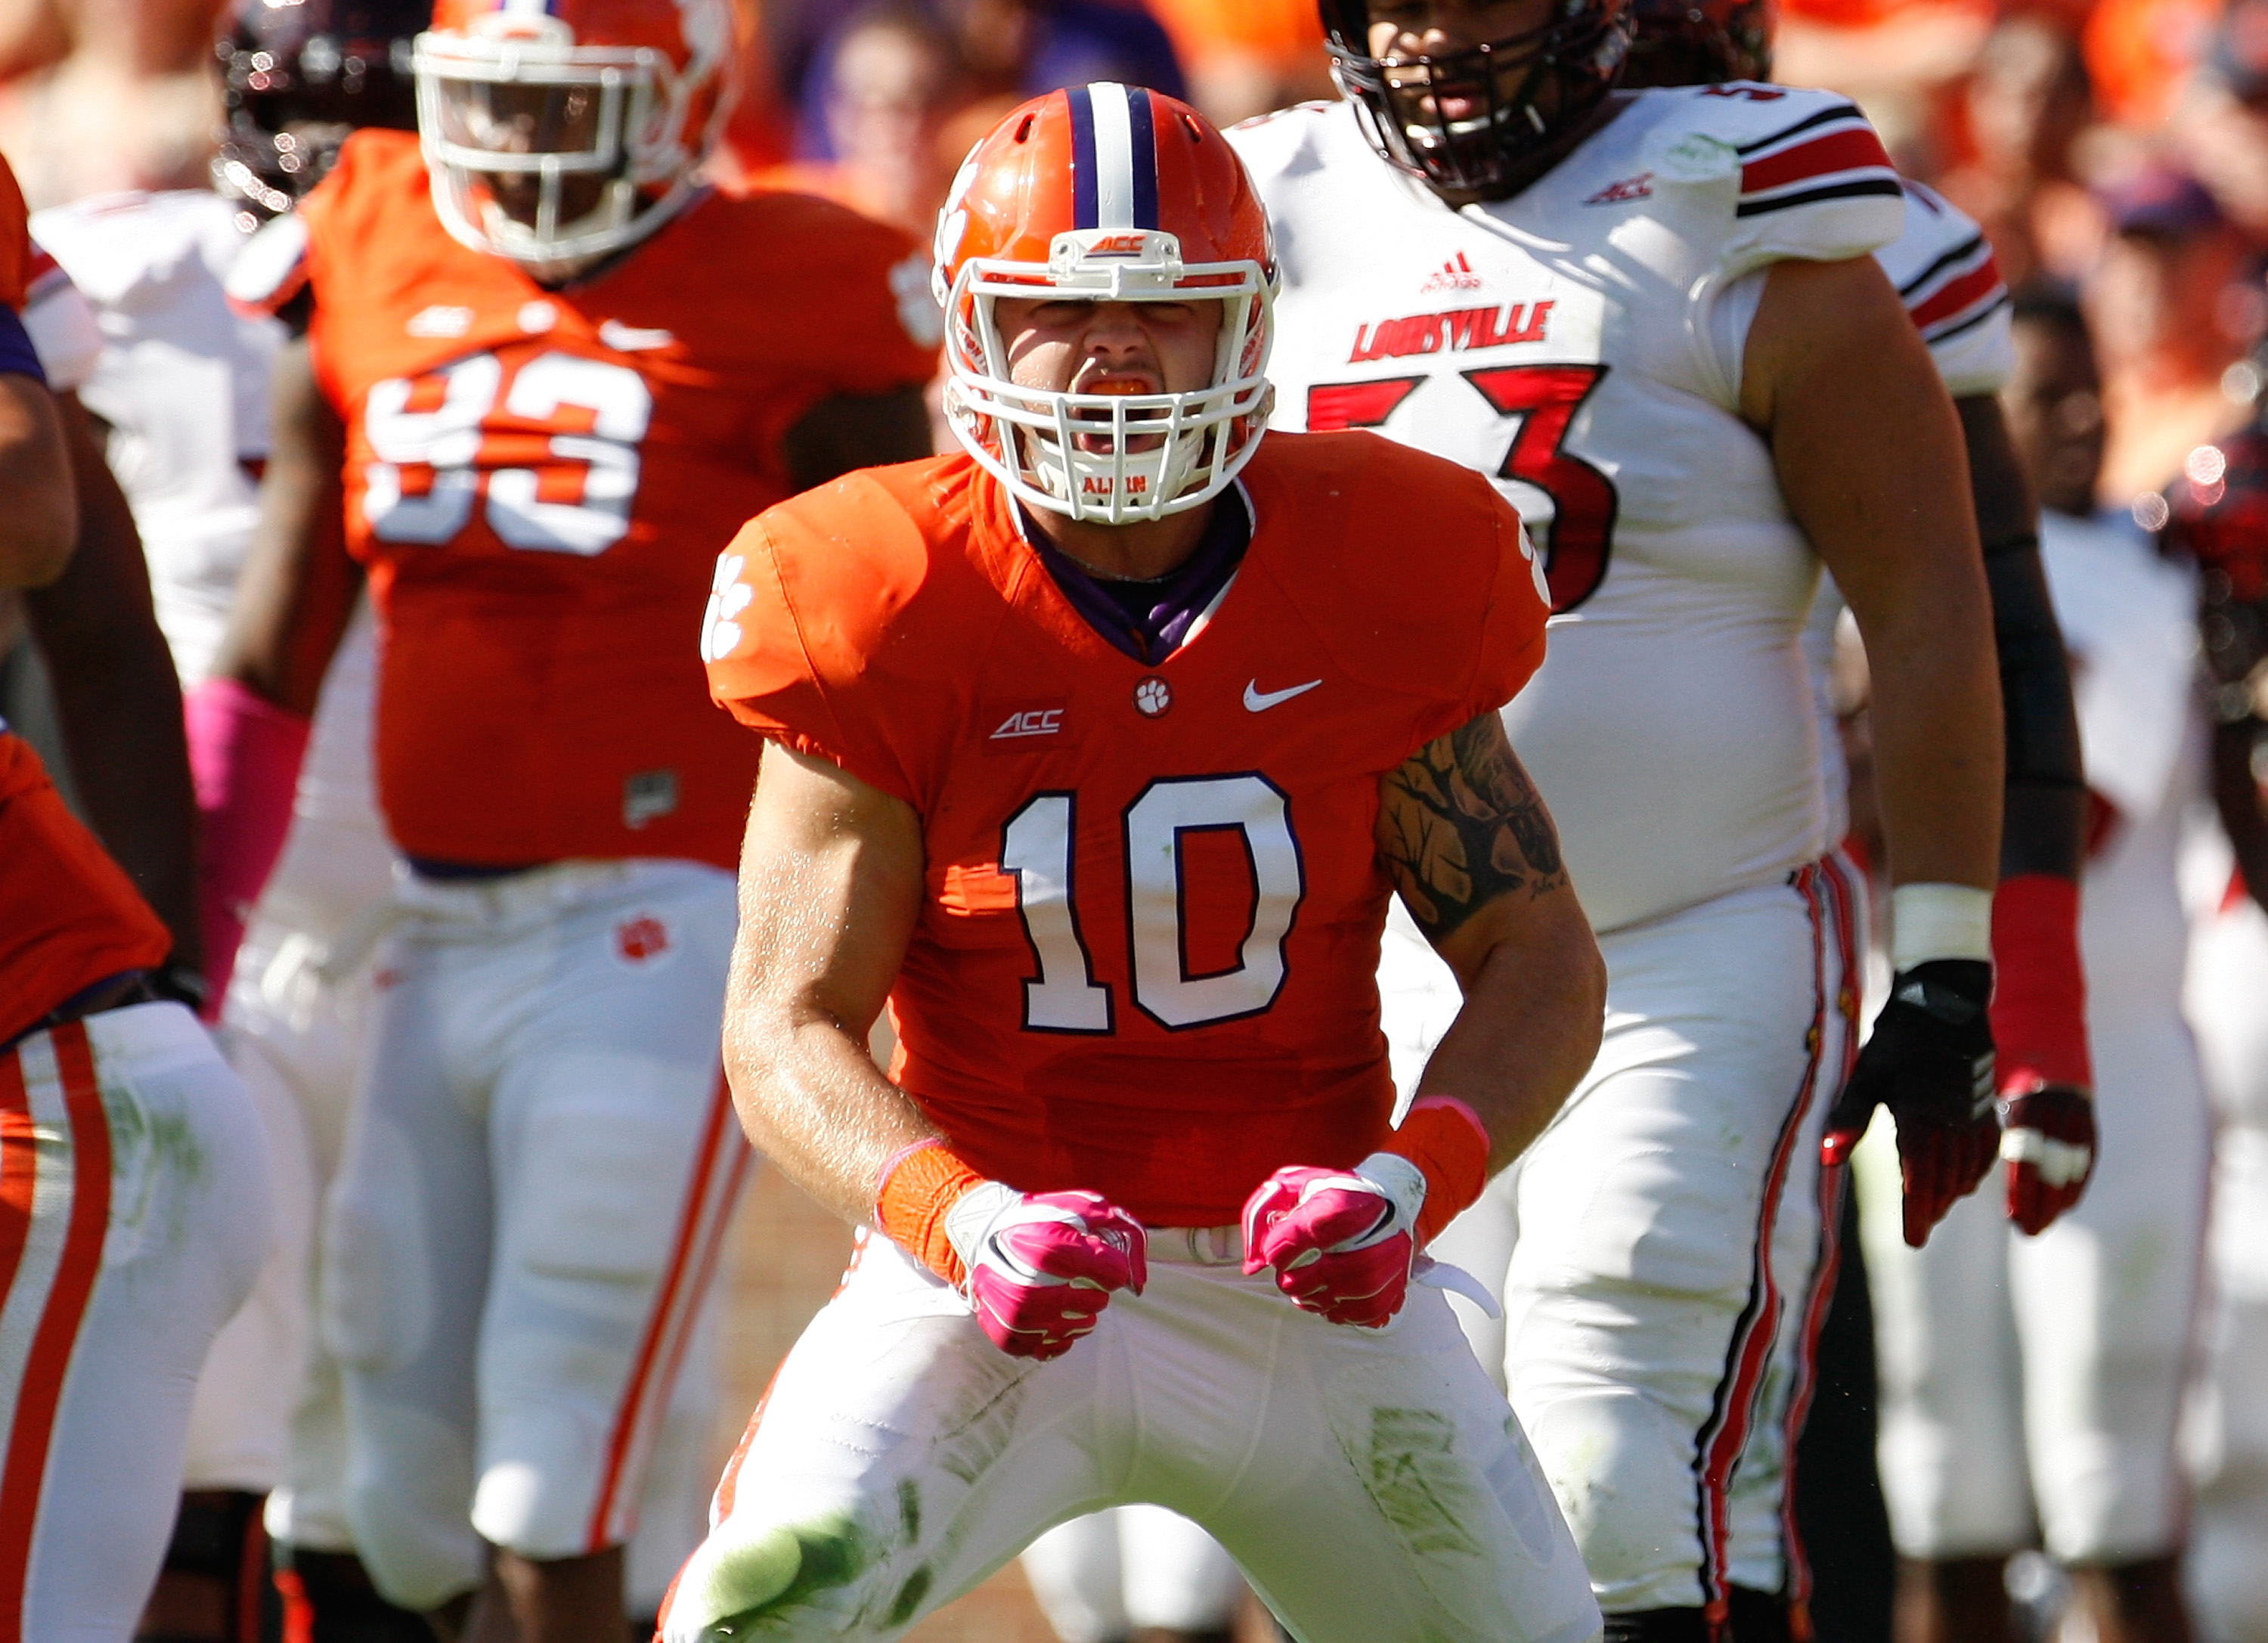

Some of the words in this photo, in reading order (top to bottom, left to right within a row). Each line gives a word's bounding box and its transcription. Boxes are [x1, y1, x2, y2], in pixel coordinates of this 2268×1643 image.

[1088, 234, 1147, 253] ACC
[1347, 301, 1554, 363] LOUISVILLE
[363, 349, 653, 558] 93
[1124, 474, 1147, 494] IN
[1306, 361, 1620, 615] 3
[991, 708, 1065, 736] ACC
[998, 770, 1307, 1037] 10
